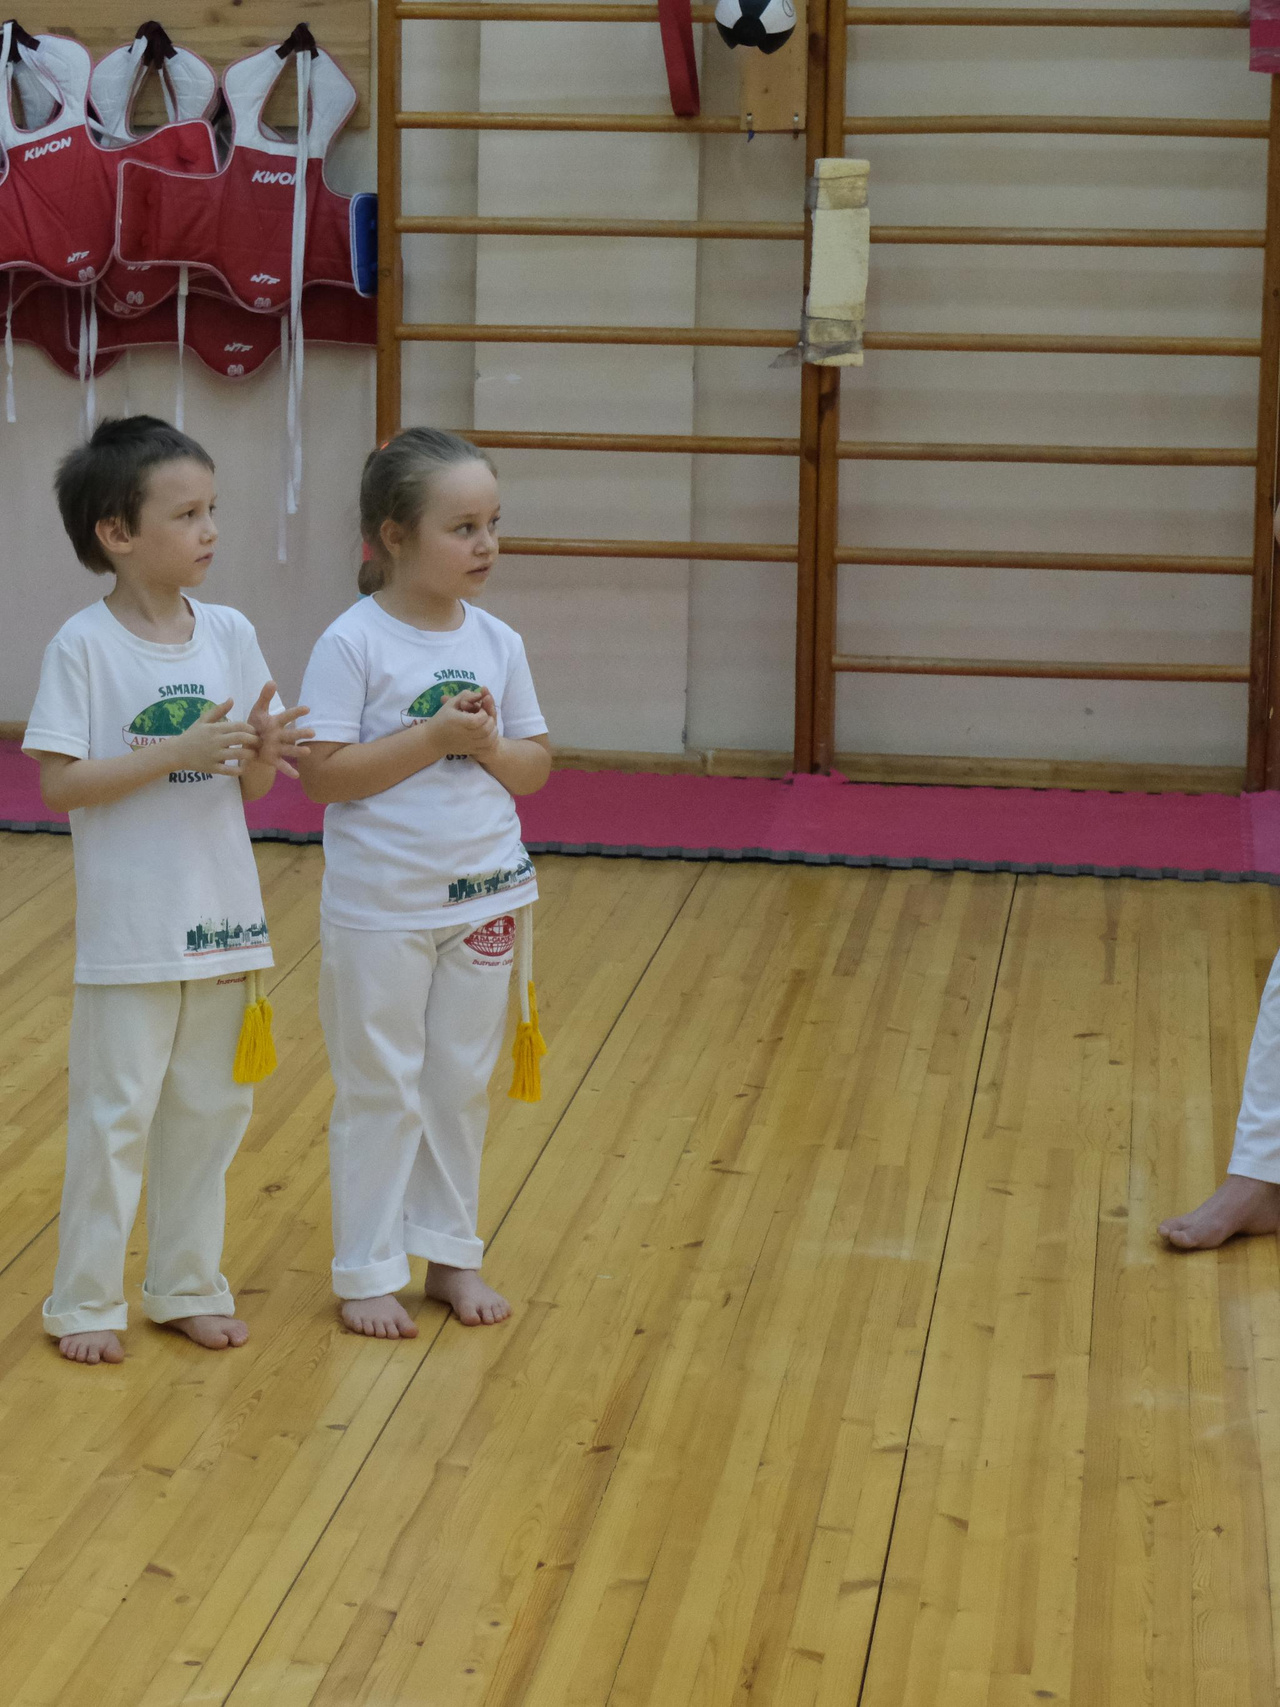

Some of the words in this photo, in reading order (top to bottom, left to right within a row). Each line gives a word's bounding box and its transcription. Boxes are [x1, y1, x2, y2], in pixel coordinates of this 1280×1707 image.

[24, 137, 72, 162] KWON
[433, 669, 476, 682] SAMARA
[158, 683, 205, 698] SAMARA
